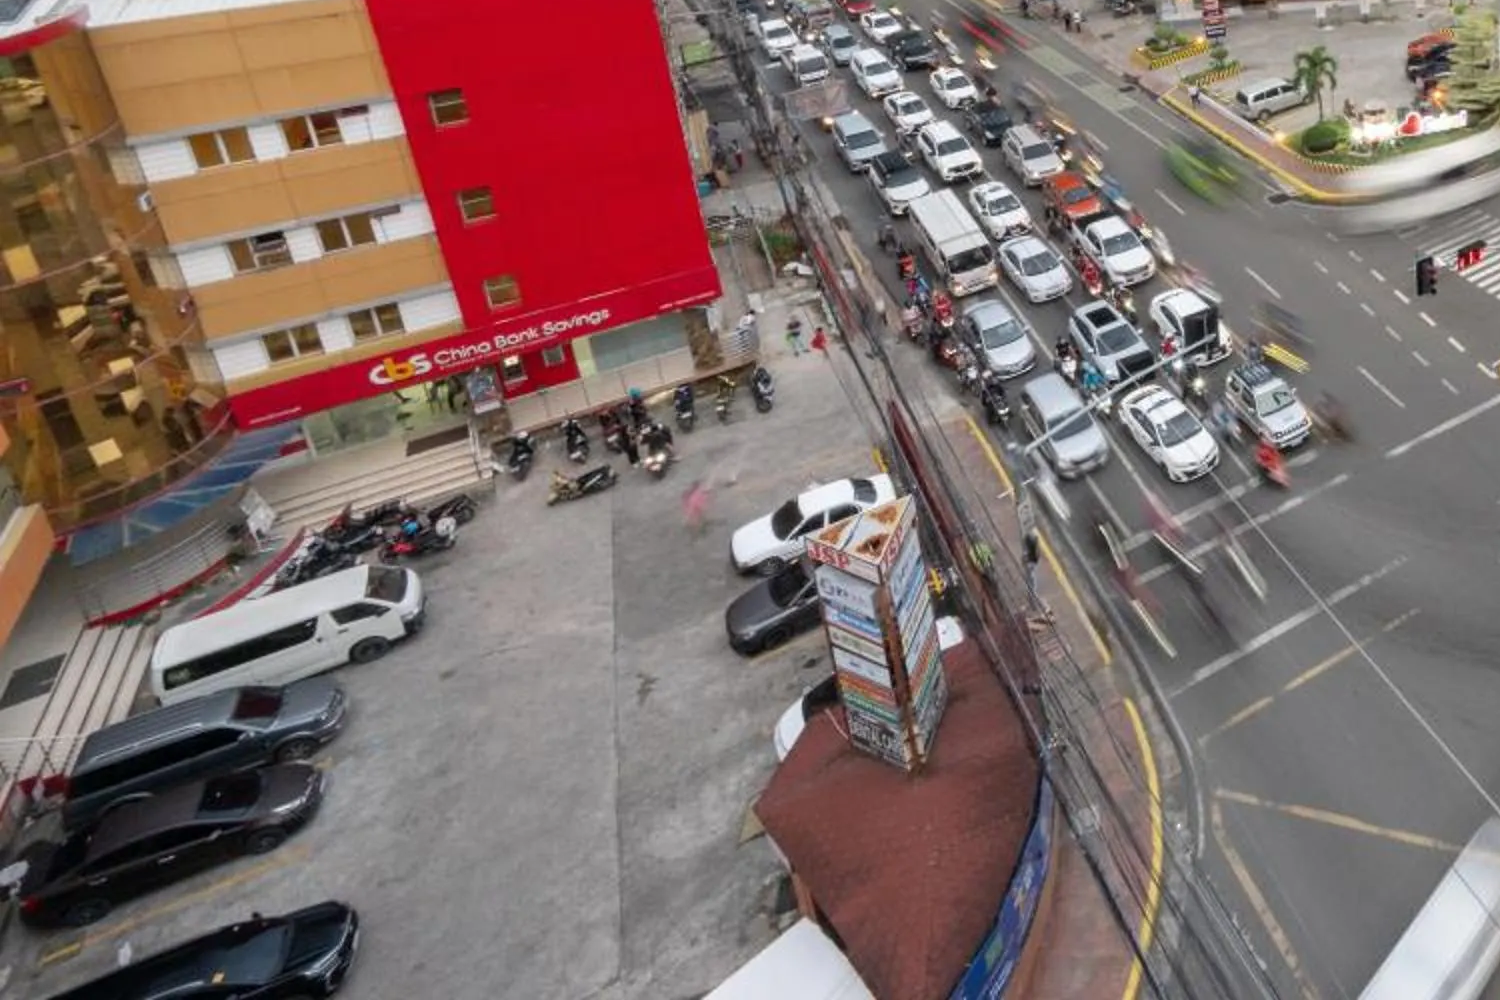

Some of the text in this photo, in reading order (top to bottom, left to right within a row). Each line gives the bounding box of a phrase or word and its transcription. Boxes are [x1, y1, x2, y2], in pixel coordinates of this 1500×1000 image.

[433, 340, 491, 366] China
[494, 324, 539, 349] Bank
[541, 308, 611, 337] Savings
